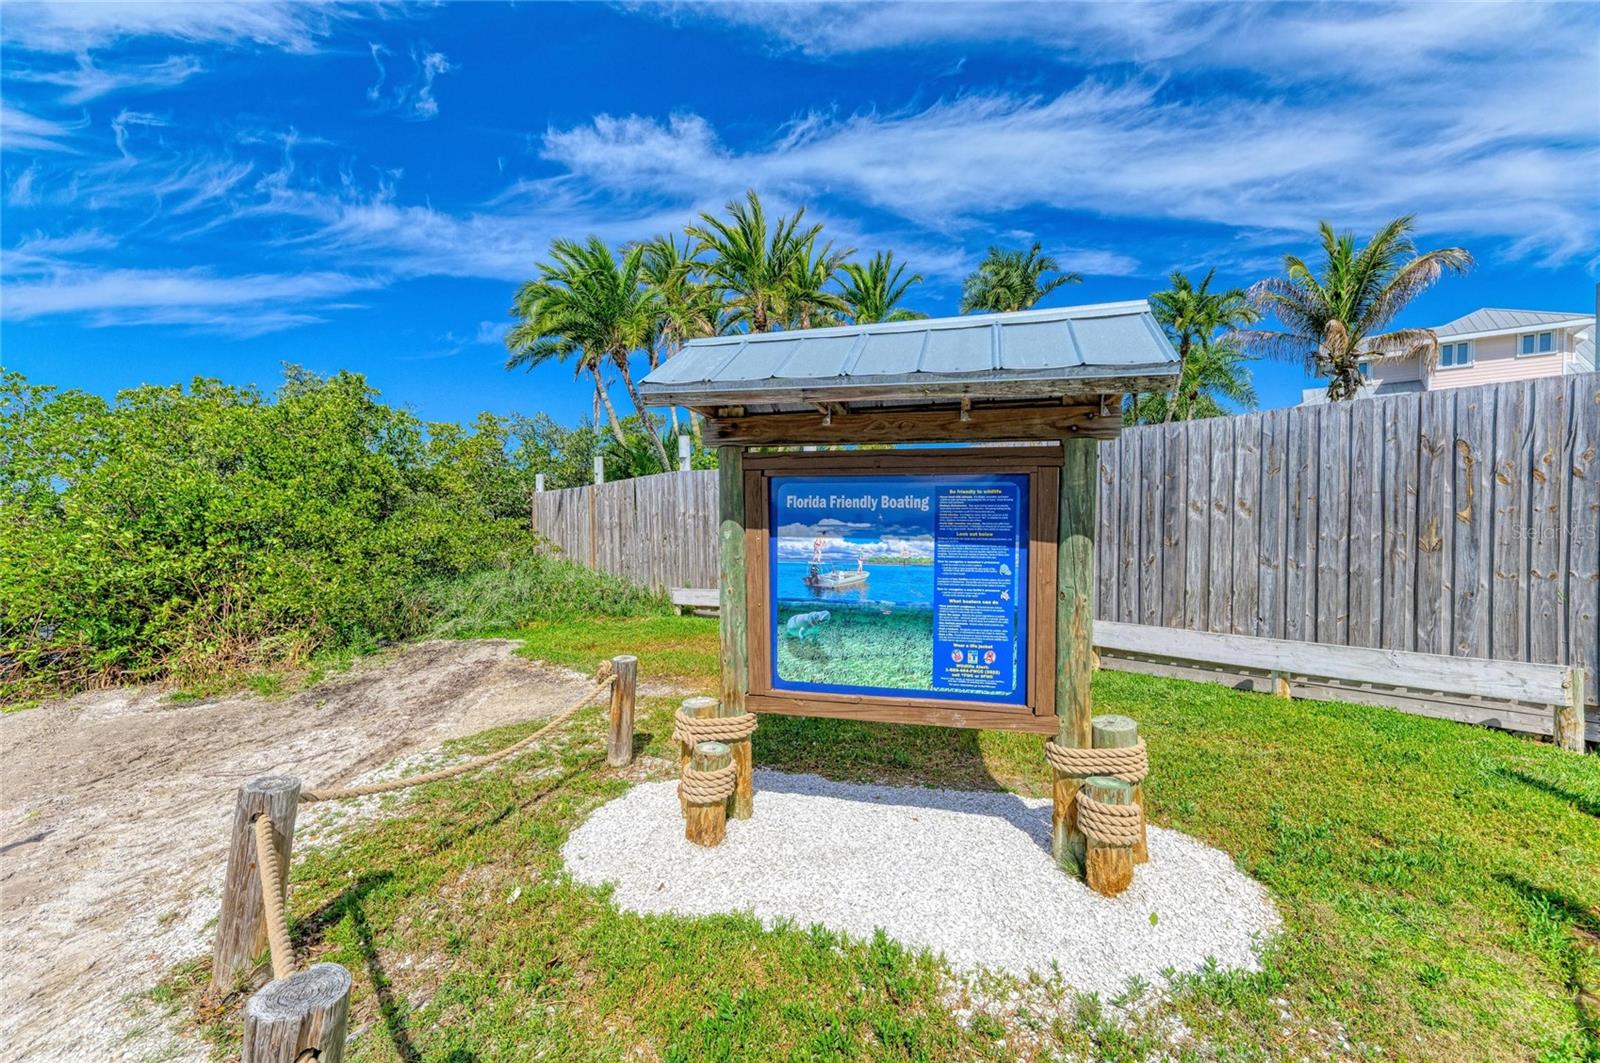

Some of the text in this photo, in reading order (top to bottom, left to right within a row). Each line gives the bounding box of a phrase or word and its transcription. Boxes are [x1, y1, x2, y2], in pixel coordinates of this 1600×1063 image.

[786, 496, 826, 508] Florida
[830, 496, 878, 511] Friendly
[881, 496, 929, 511] Boating
